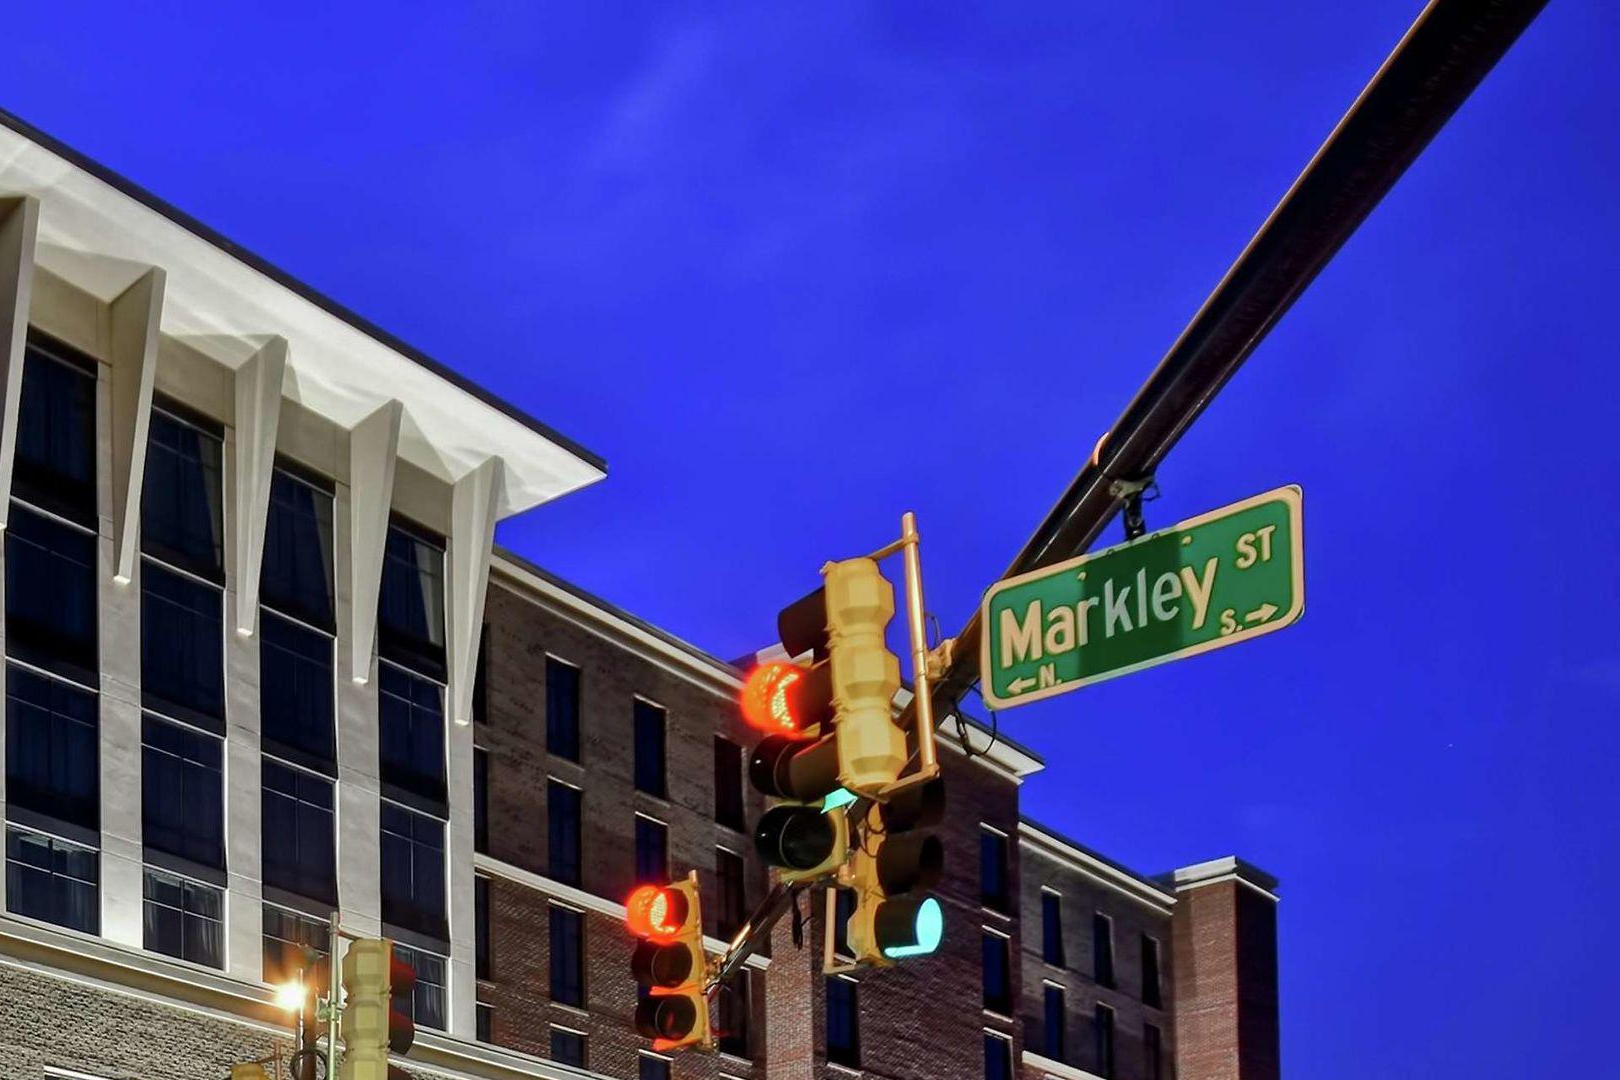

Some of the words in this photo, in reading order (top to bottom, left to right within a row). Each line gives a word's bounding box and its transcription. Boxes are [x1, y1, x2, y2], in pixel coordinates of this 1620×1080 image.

[1000, 557, 1218, 669] Markley
[1235, 524, 1276, 569] ST
[1220, 608, 1243, 636] S.
[1039, 662, 1062, 689] N.
